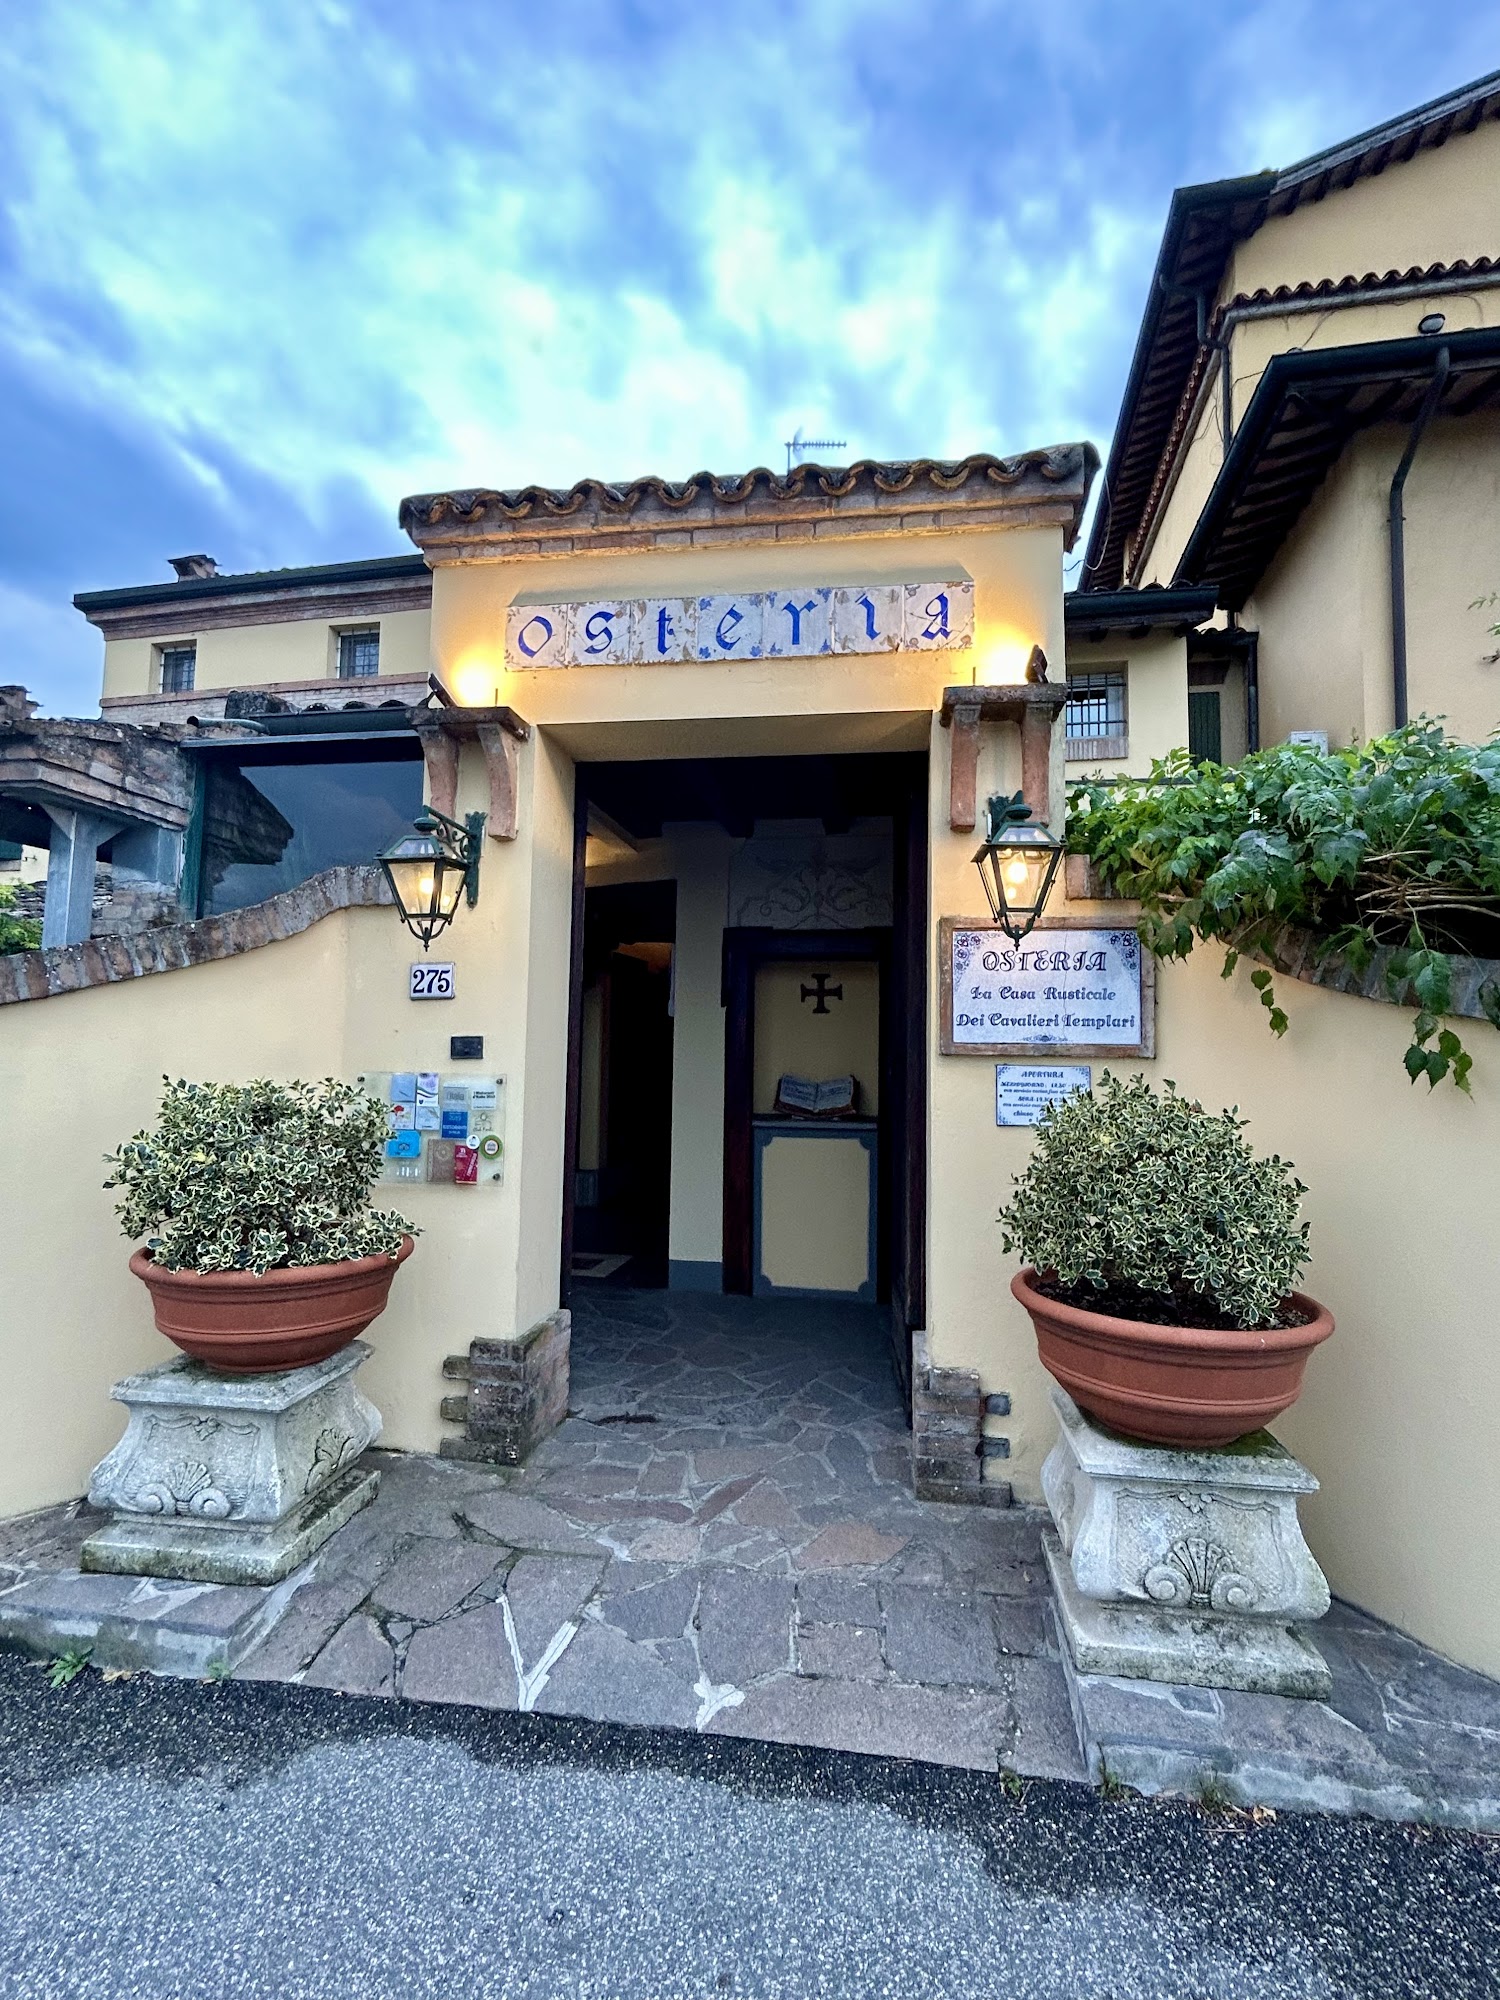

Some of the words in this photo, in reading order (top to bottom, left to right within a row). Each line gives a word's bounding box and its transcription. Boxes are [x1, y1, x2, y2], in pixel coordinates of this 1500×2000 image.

[517, 592, 954, 659] osteria
[982, 949, 1107, 972] OSTERIA
[412, 969, 451, 994] 275
[970, 985, 992, 1000] La
[999, 985, 1036, 1000] Casa
[1043, 986, 1116, 1001] Rusticale
[955, 1013, 985, 1027] Dei
[988, 1012, 1059, 1027] Cavalieri
[1061, 1012, 1135, 1029] Templari
[1021, 1070, 1064, 1078] APERTURA
